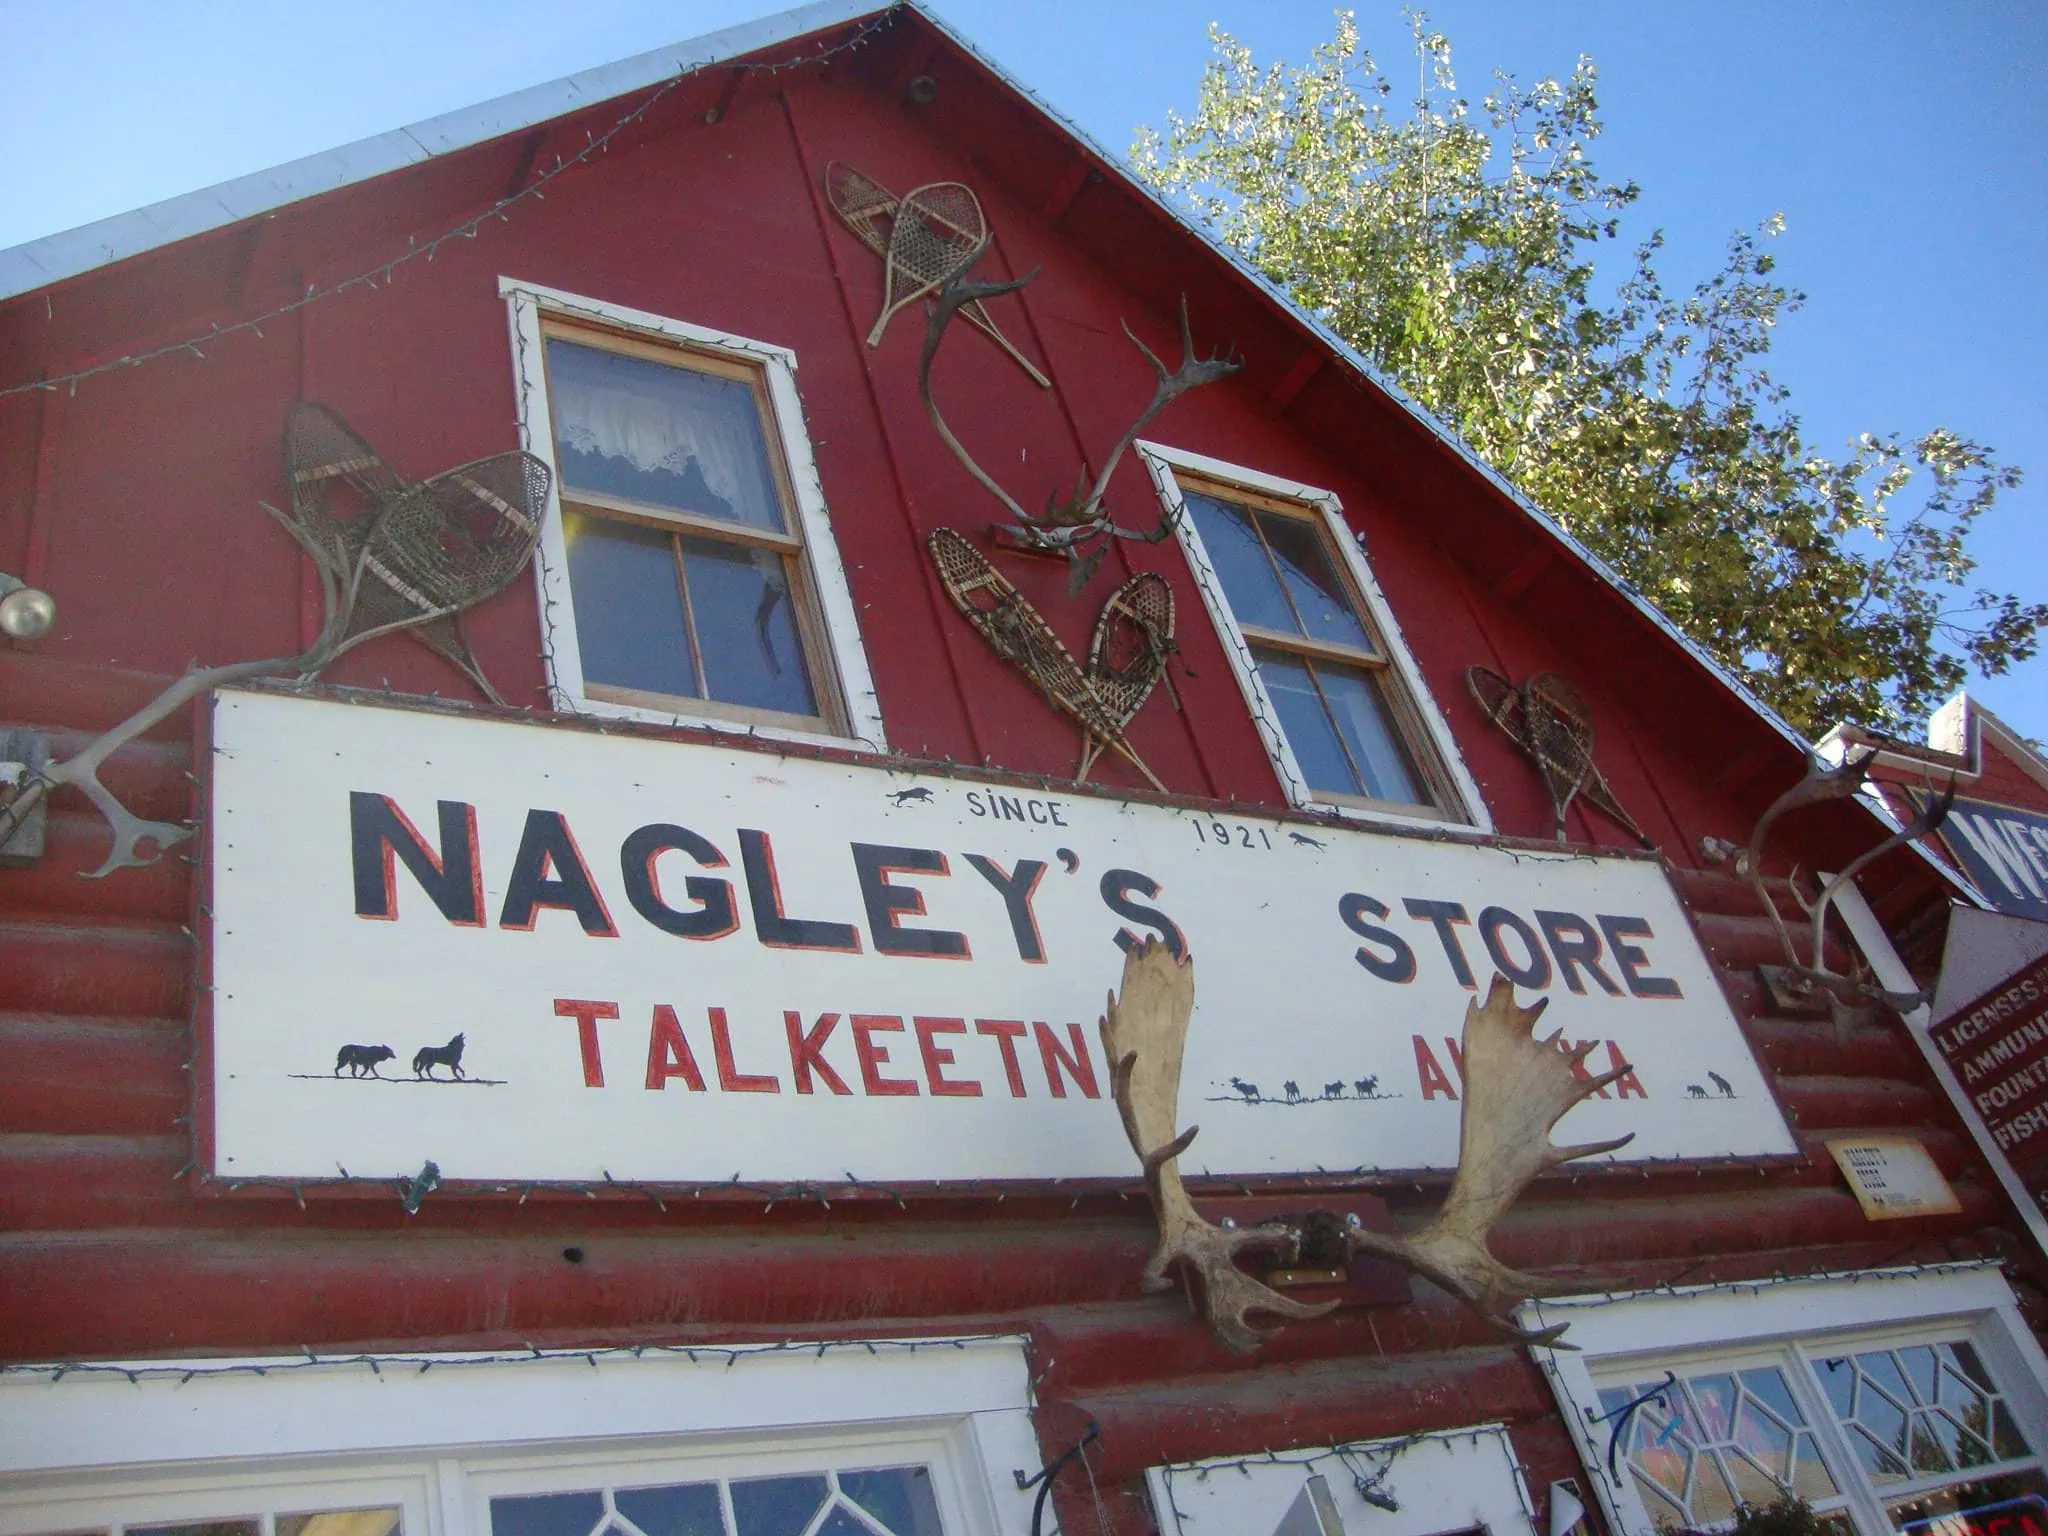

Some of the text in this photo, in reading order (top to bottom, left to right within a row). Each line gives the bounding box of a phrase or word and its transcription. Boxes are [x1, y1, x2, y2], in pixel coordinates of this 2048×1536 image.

[1191, 817, 1272, 851] 1921
[349, 790, 1685, 1000] NAGLEY'S STORE
[553, 998, 1649, 1101] TALKEETN AKA
[1938, 979, 2040, 1054] LICENSES
[1963, 1009, 2048, 1084] AMMUNI
[1975, 1055, 2048, 1116] FOUNT
[1993, 1101, 2048, 1150] FISH
